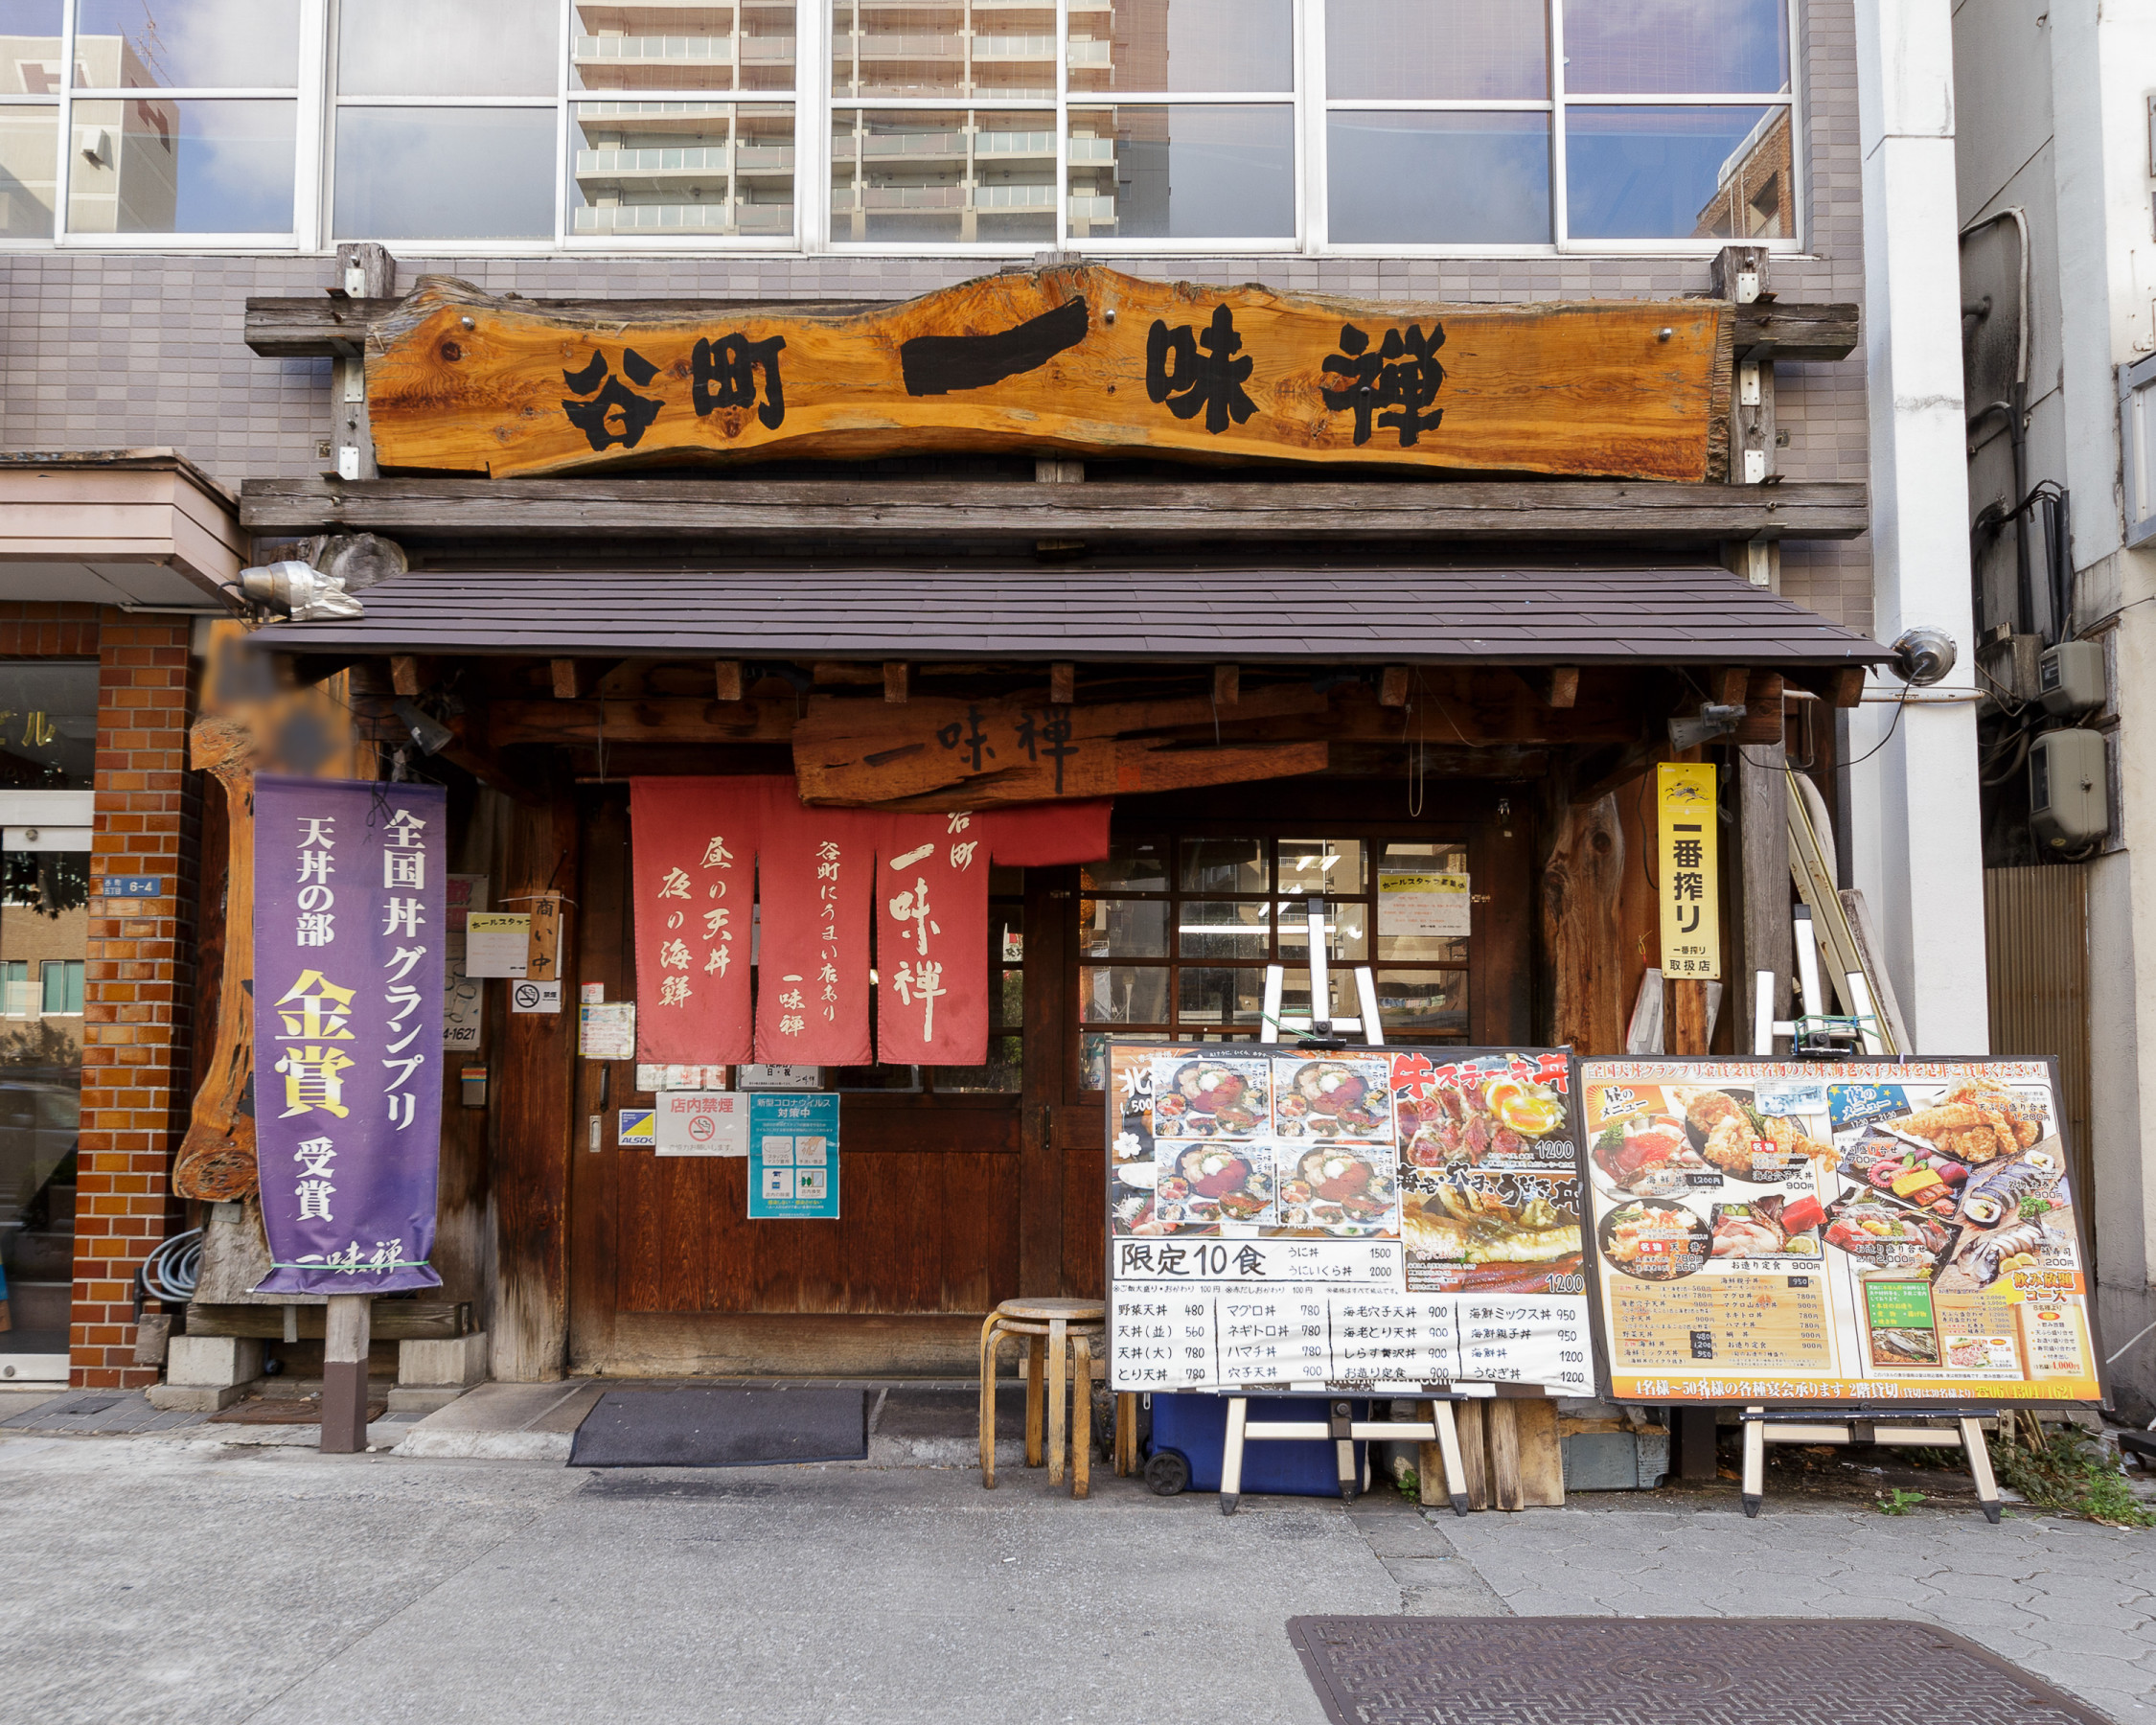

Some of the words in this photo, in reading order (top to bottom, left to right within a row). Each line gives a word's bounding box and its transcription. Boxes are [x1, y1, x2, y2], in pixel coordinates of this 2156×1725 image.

[863, 705, 1080, 794] 一味禅
[1673, 823, 1704, 933] 一番搾り
[129, 882, 153, 892] 6-4
[700, 836, 734, 978] 昼の天丼
[531, 898, 556, 974] 商い中
[657, 866, 694, 1009] 夜の海鮮
[816, 840, 843, 1023] 谷町にうまい店あり
[889, 843, 948, 1043] 一味禅
[1673, 945, 1707, 955] 一番搾り
[1669, 959, 1710, 972] 取扱店
[778, 974, 806, 1038] 一味禅
[274, 968, 357, 1119] 金賞
[1389, 1052, 1570, 1100] 牛ステーキ丼
[1604, 1086, 1635, 1104] 昼の
[1845, 1085, 1877, 1104] 夜の
[670, 1097, 734, 1114] 店内禁煙
[757, 1098, 832, 1108] 新型コロナウイルス
[1600, 1099, 1648, 1119] メニュー
[1842, 1098, 1892, 1121] メニュー
[1978, 1103, 2049, 1113] 天ぷら盛り合せ
[777, 1107, 811, 1118] 対策中
[2012, 1113, 2051, 1122] 1,200円
[1535, 1139, 1574, 1160] 1200
[1752, 1142, 1776, 1152] 名物
[1839, 1145, 1898, 1154] 寿司盛り合せ
[293, 1137, 335, 1223] 受賞
[1752, 1171, 1814, 1181] 海老穴子天丼
[1786, 1182, 1815, 1190] 900円
[2033, 1190, 2063, 1199] 900円
[1288, 1247, 1319, 1258] うに丼
[1369, 1248, 1391, 1258] 1500
[1856, 1244, 1926, 1254] お造り盛り合せ
[295, 1237, 405, 1276] 一味禅
[1121, 1242, 1267, 1276] 限定10食
[1674, 1254, 1704, 1263] 780円
[2036, 1257, 2075, 1267] 1,200円
[1288, 1265, 1353, 1277] うにいくら丼
[1369, 1266, 1392, 1277] 2000
[1675, 1263, 1704, 1272] 560円
[1731, 1260, 1781, 1271] お造り定食
[1791, 1261, 1821, 1271] 900円
[1546, 1274, 1585, 1294] 1200
[2013, 1271, 2075, 1289] 飲み放題
[2026, 1288, 2068, 1303] コース
[1118, 1303, 1168, 1317] 野菜天丼
[1184, 1304, 1204, 1317] 480
[1227, 1304, 1276, 1317] マグロ丼
[1300, 1304, 1320, 1316] 780
[1343, 1305, 1417, 1318] 海老穴子天丼
[1428, 1306, 1448, 1318] 900
[1469, 1307, 1552, 1321] 海鮮ミックス丼
[1556, 1309, 1576, 1322] 950
[1117, 1324, 1173, 1340] 天丼(並)
[1185, 1326, 1204, 1338] 560
[1227, 1324, 1290, 1337] ネギトロ丼
[1301, 1325, 1321, 1337] 780
[1343, 1326, 1417, 1339] 海老とり天丼
[1429, 1327, 1449, 1338] 900
[1471, 1327, 1532, 1340] 海鮮親子丼
[1557, 1329, 1577, 1342] 950
[1227, 1346, 1277, 1358] ハマチ丼
[1302, 1346, 1321, 1357] 780
[1728, 1341, 1767, 1349] お造り定食
[1117, 1346, 1173, 1360] 天丼(大)
[1185, 1346, 1205, 1359] 780
[1428, 1348, 1448, 1359] 900
[1471, 1347, 1508, 1359] 海鮮丼
[1559, 1350, 1584, 1363] 1200
[1118, 1368, 1168, 1381] とり天丼
[1185, 1368, 1205, 1380] 780
[1227, 1368, 1277, 1379] 穴子天丼
[1303, 1366, 1322, 1377] 900
[1344, 1367, 1407, 1379] お造り定食
[1430, 1367, 1450, 1379] 900
[1474, 1367, 1522, 1380] うなぎ丼
[1560, 1371, 1585, 1383] 1200
[1848, 1382, 1899, 1400] 2階貸切
